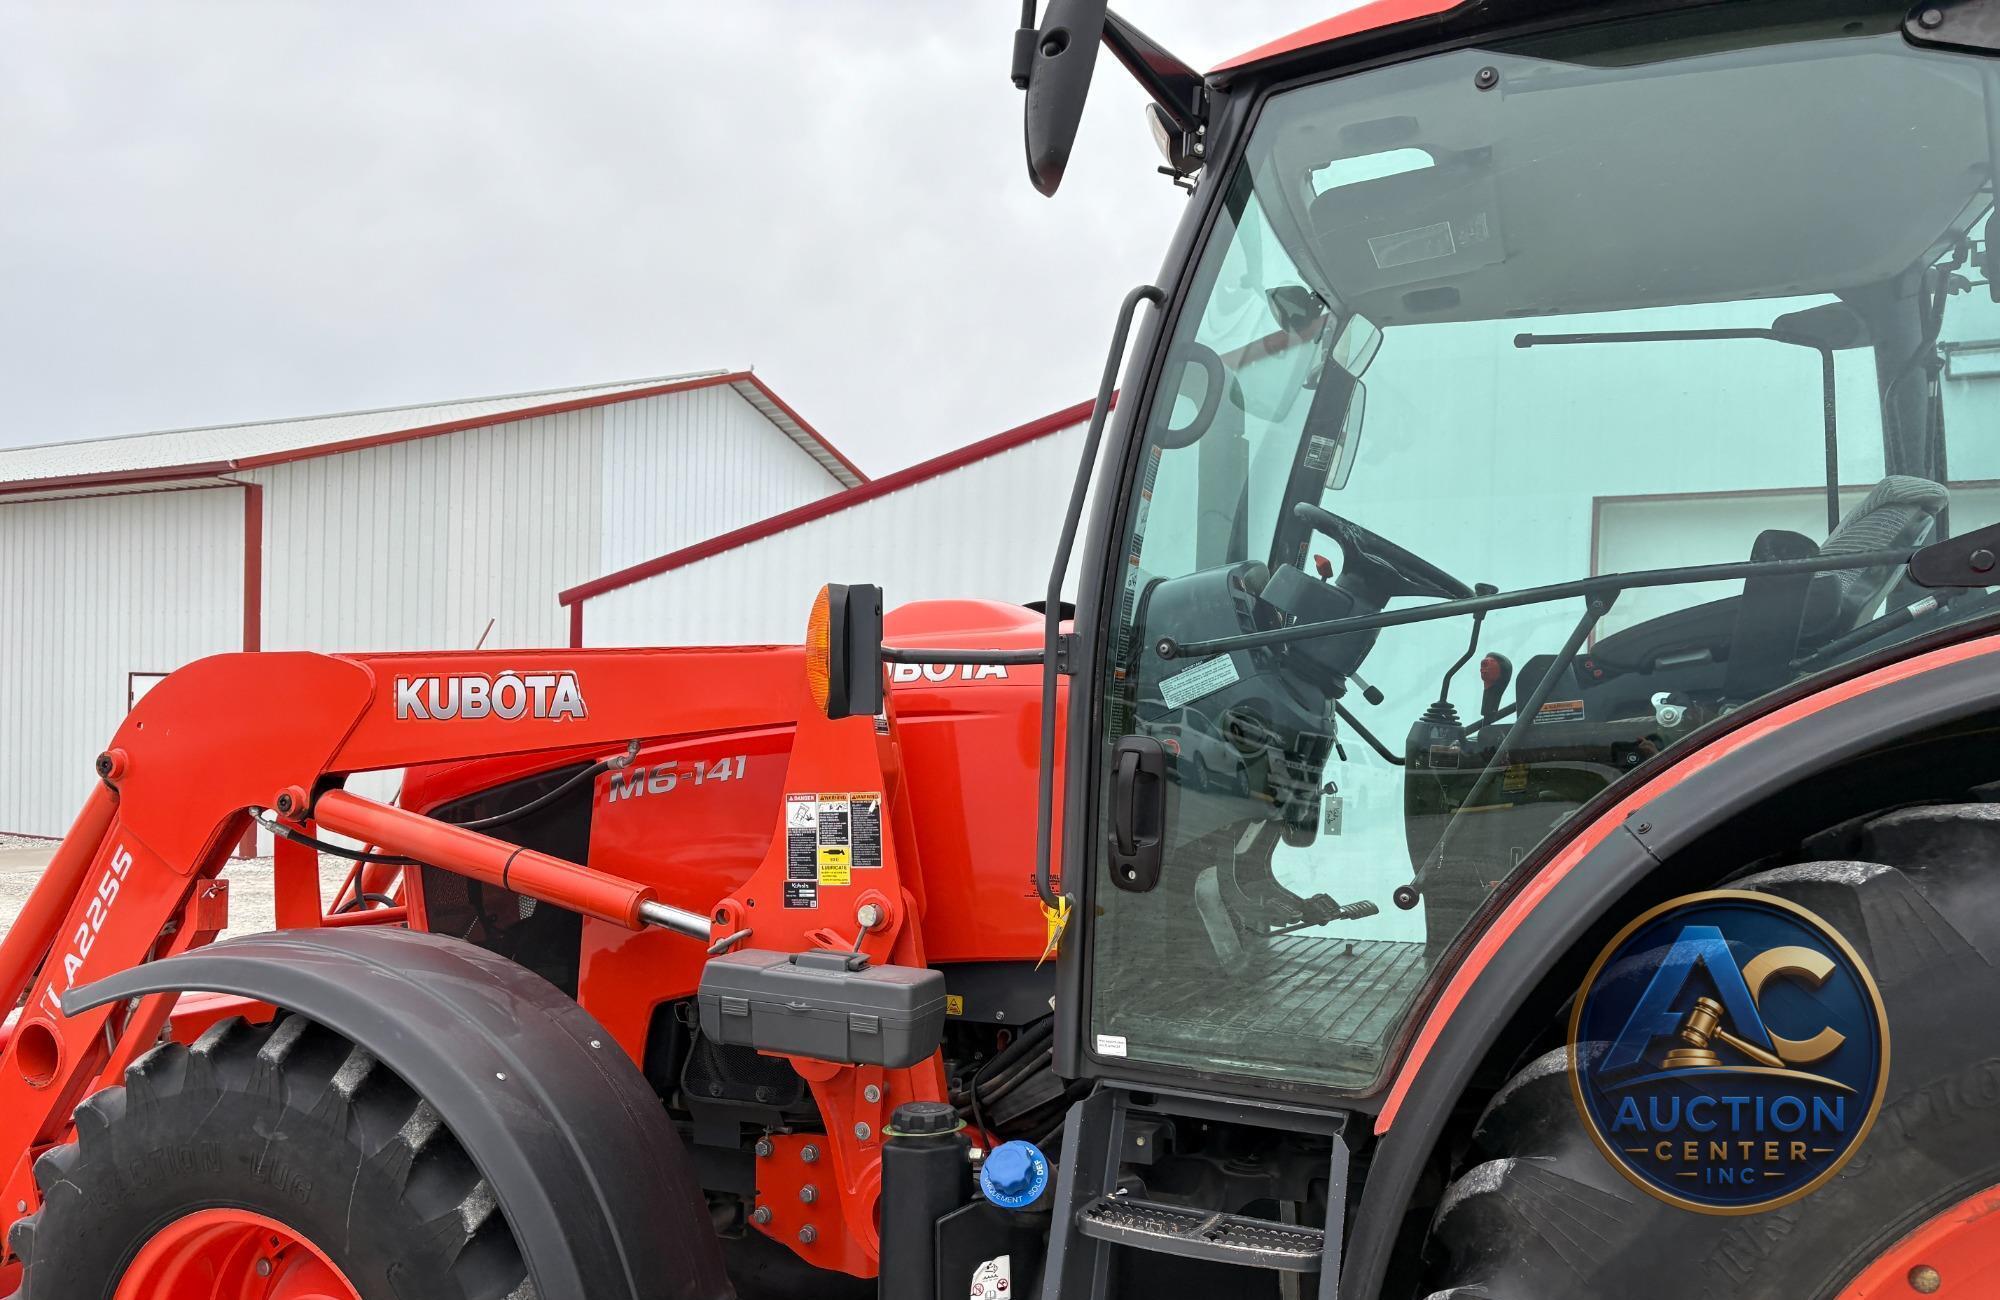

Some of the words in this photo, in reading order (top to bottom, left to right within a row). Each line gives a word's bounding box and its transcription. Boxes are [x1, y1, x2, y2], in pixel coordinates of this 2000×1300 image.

[396, 673, 586, 720] KUBOTA
[608, 754, 747, 803] M6-141
[1034, 1159, 1044, 1176] DEF
[1028, 1177, 1043, 1197] SOLO
